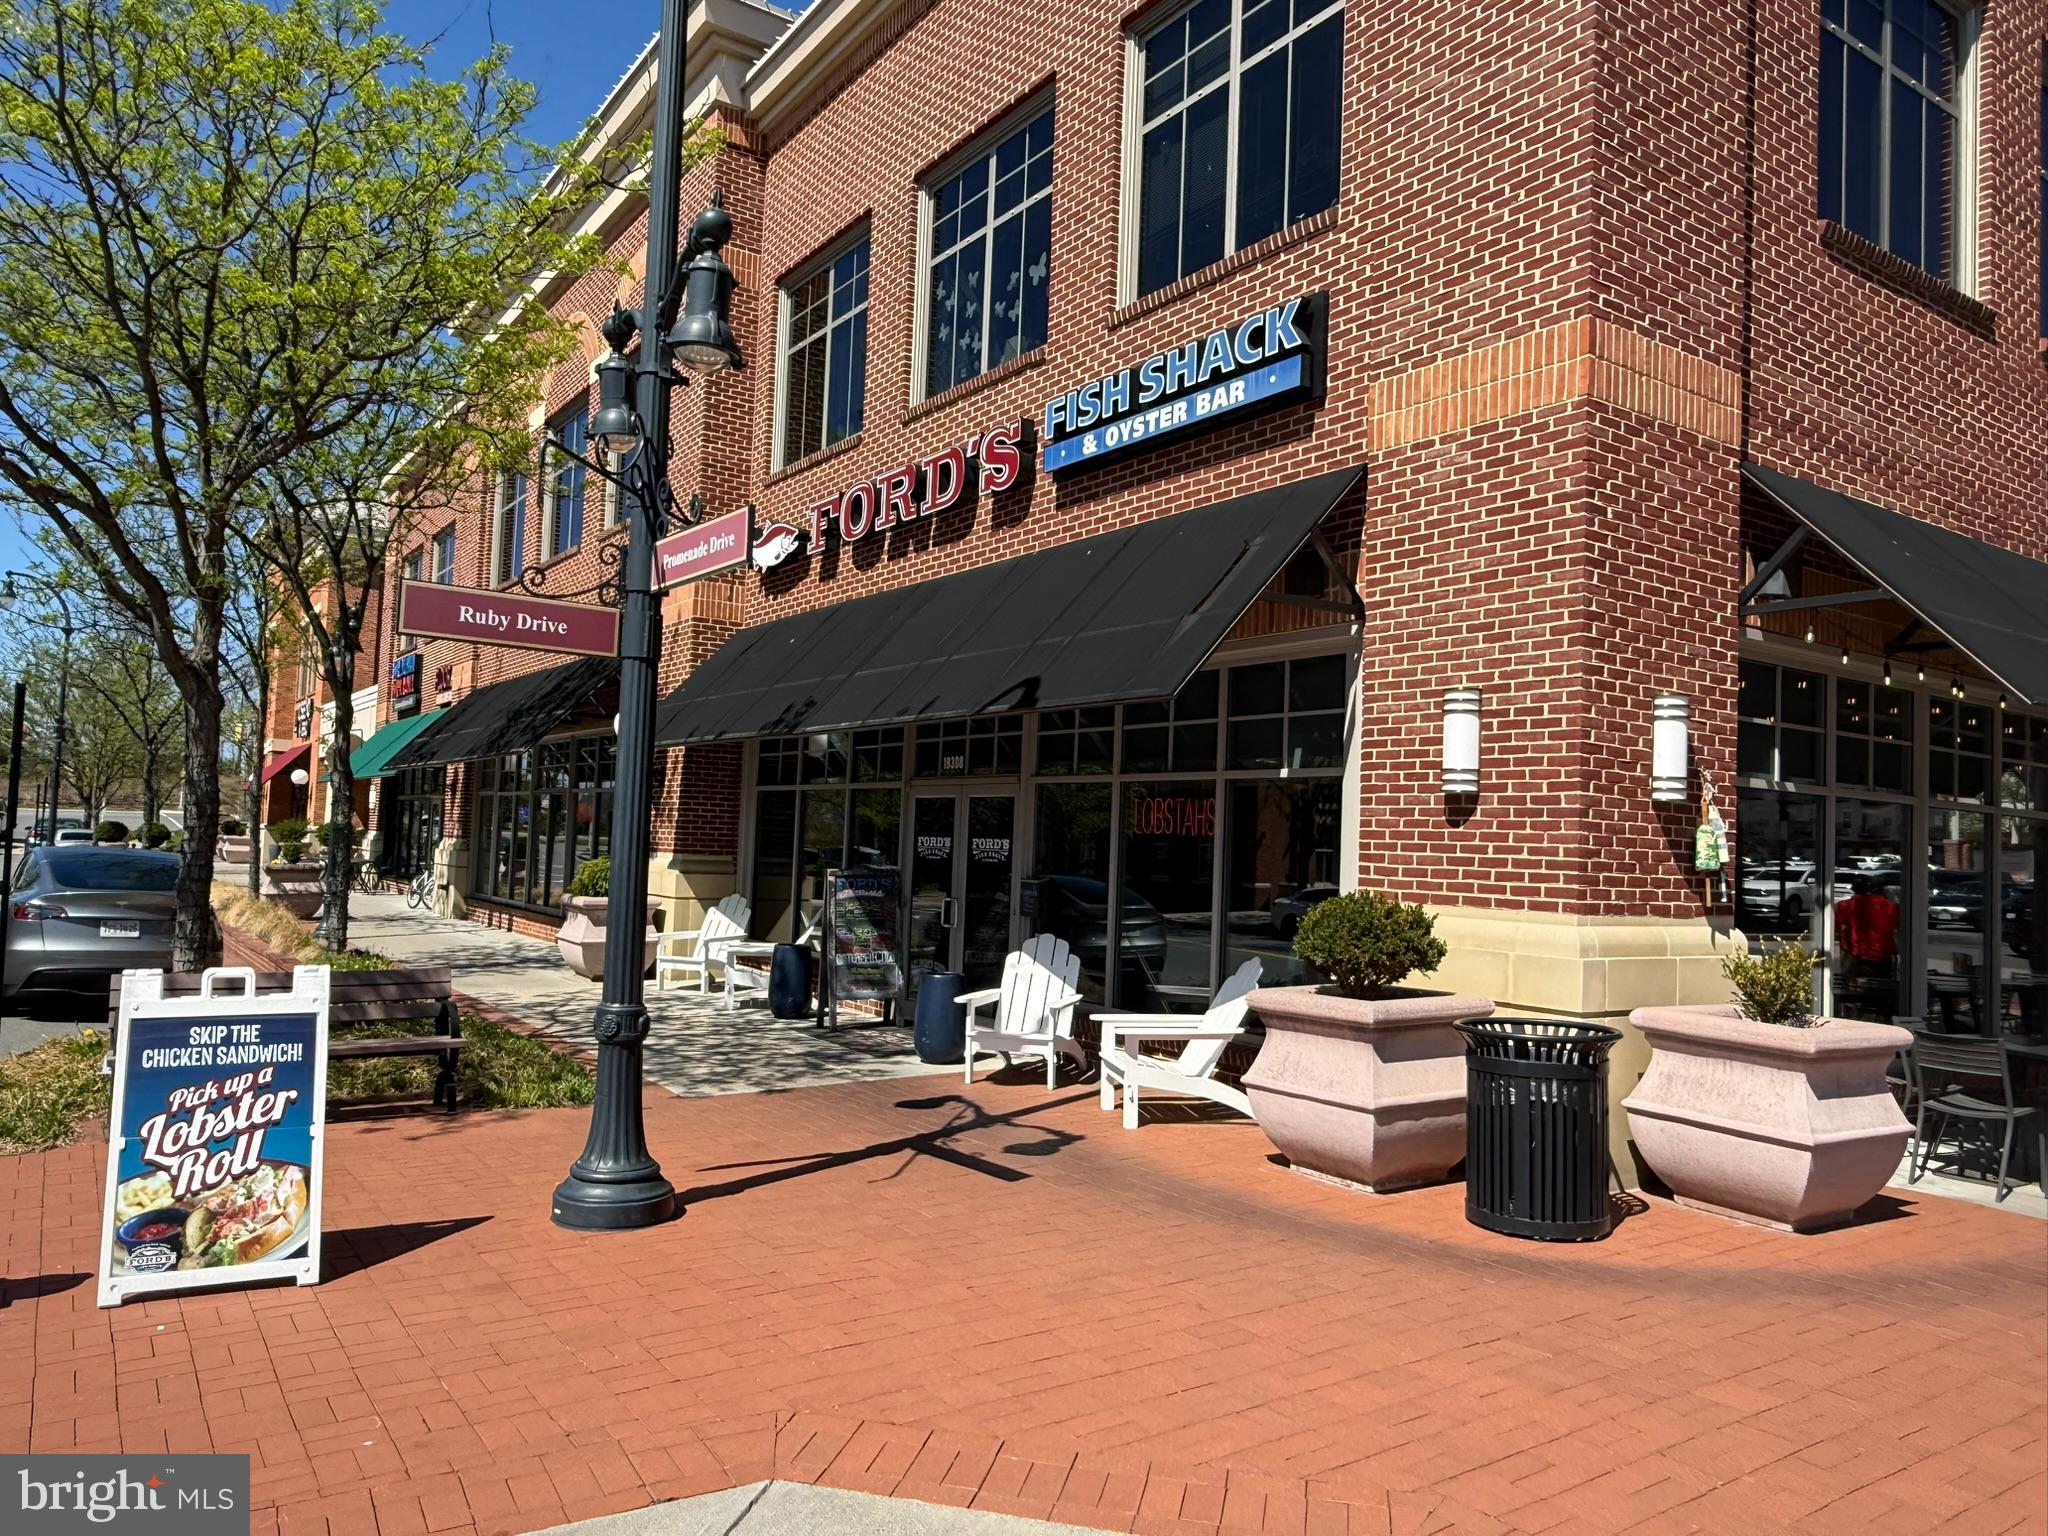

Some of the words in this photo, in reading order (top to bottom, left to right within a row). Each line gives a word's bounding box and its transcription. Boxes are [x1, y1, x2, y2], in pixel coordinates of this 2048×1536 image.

[1045, 368, 1130, 440] FISH
[1139, 300, 1303, 404] SHACK
[1082, 434, 1098, 455] &
[1105, 400, 1188, 448] OYSTER
[1196, 380, 1246, 416] BAR
[806, 419, 1022, 555] FORD'S
[663, 540, 709, 570] Promenade
[709, 532, 735, 554] Drive
[458, 605, 511, 632] Ruby
[516, 612, 568, 635] Drive
[1134, 798, 1216, 837] LOBSTAHS
[917, 836, 952, 847] FORD'S
[971, 838, 1008, 850] FORD'S
[189, 1026, 228, 1046] SKIP
[231, 1024, 262, 1043] THE
[142, 1046, 213, 1068] CHICKEN
[216, 1043, 304, 1065] SANDWICH!
[169, 1080, 220, 1112] Pick
[223, 1072, 254, 1098] up
[257, 1066, 275, 1084] a
[140, 1089, 299, 1167] Lobster
[170, 1129, 265, 1197] Roll
